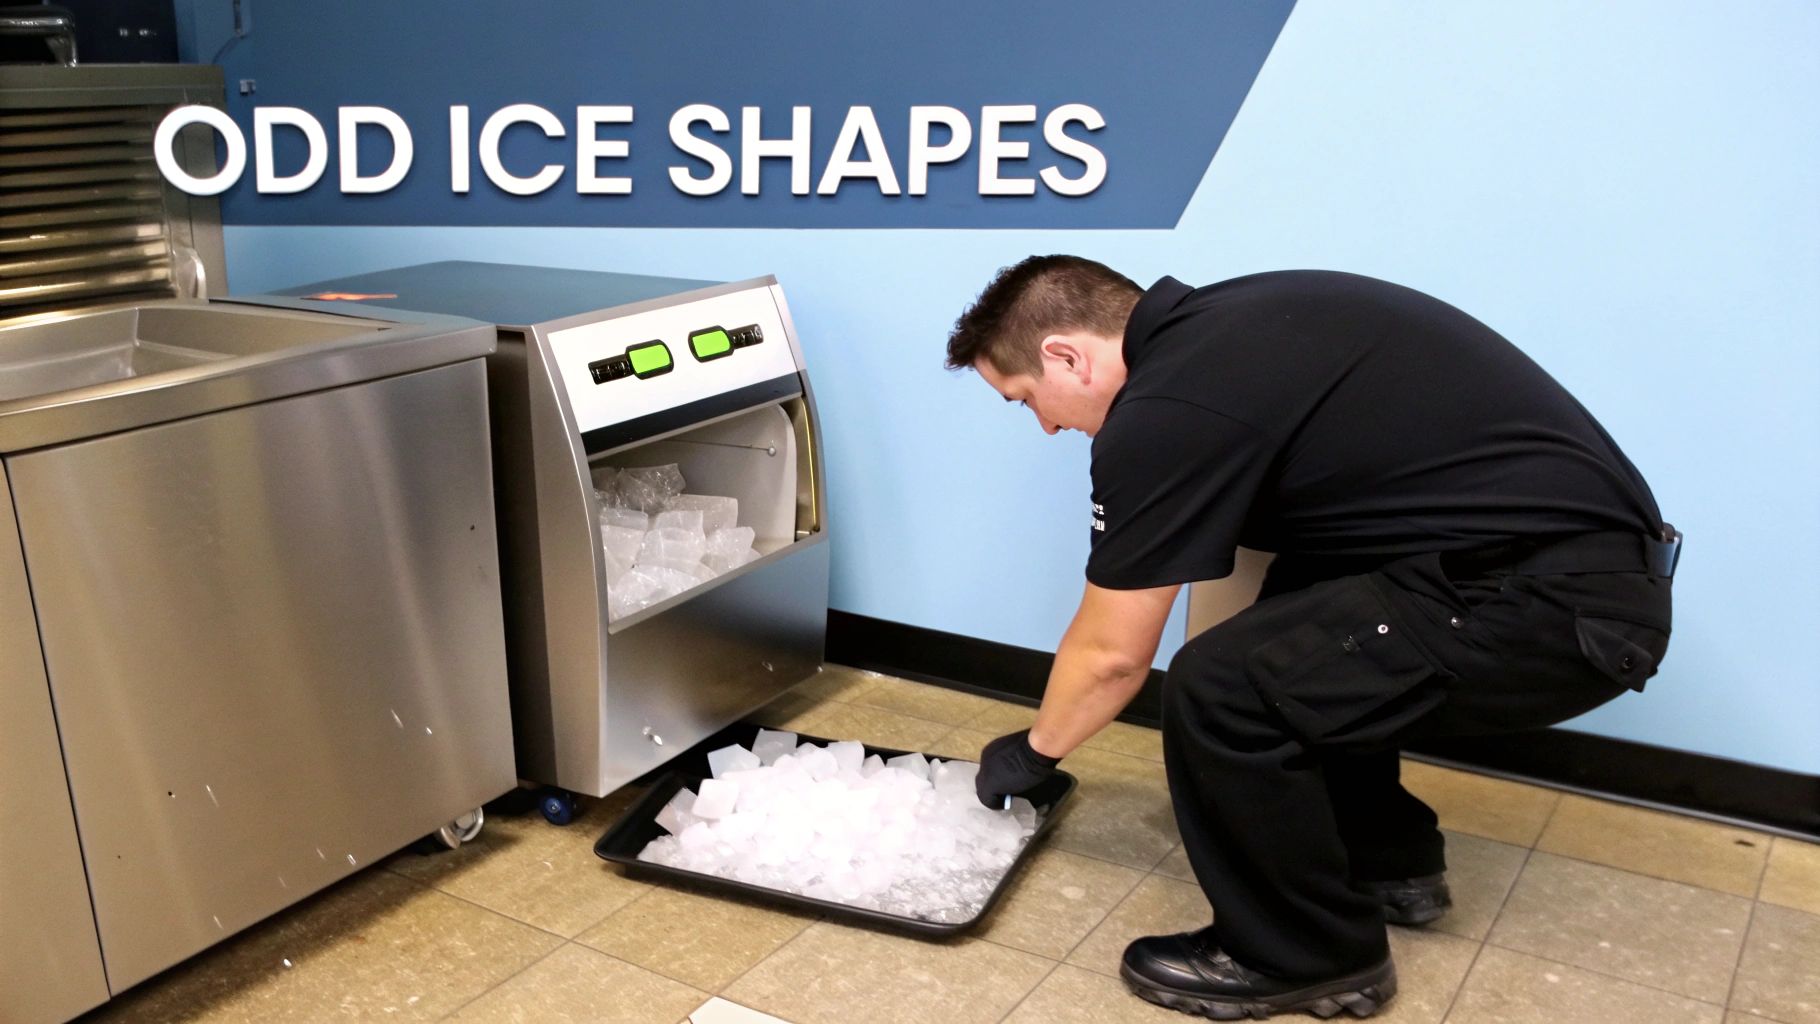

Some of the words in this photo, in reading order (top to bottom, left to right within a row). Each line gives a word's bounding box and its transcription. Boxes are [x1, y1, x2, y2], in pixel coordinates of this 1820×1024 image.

[154, 104, 414, 195] ODD
[449, 103, 634, 195] ICE
[667, 103, 1108, 195] SHAPES
